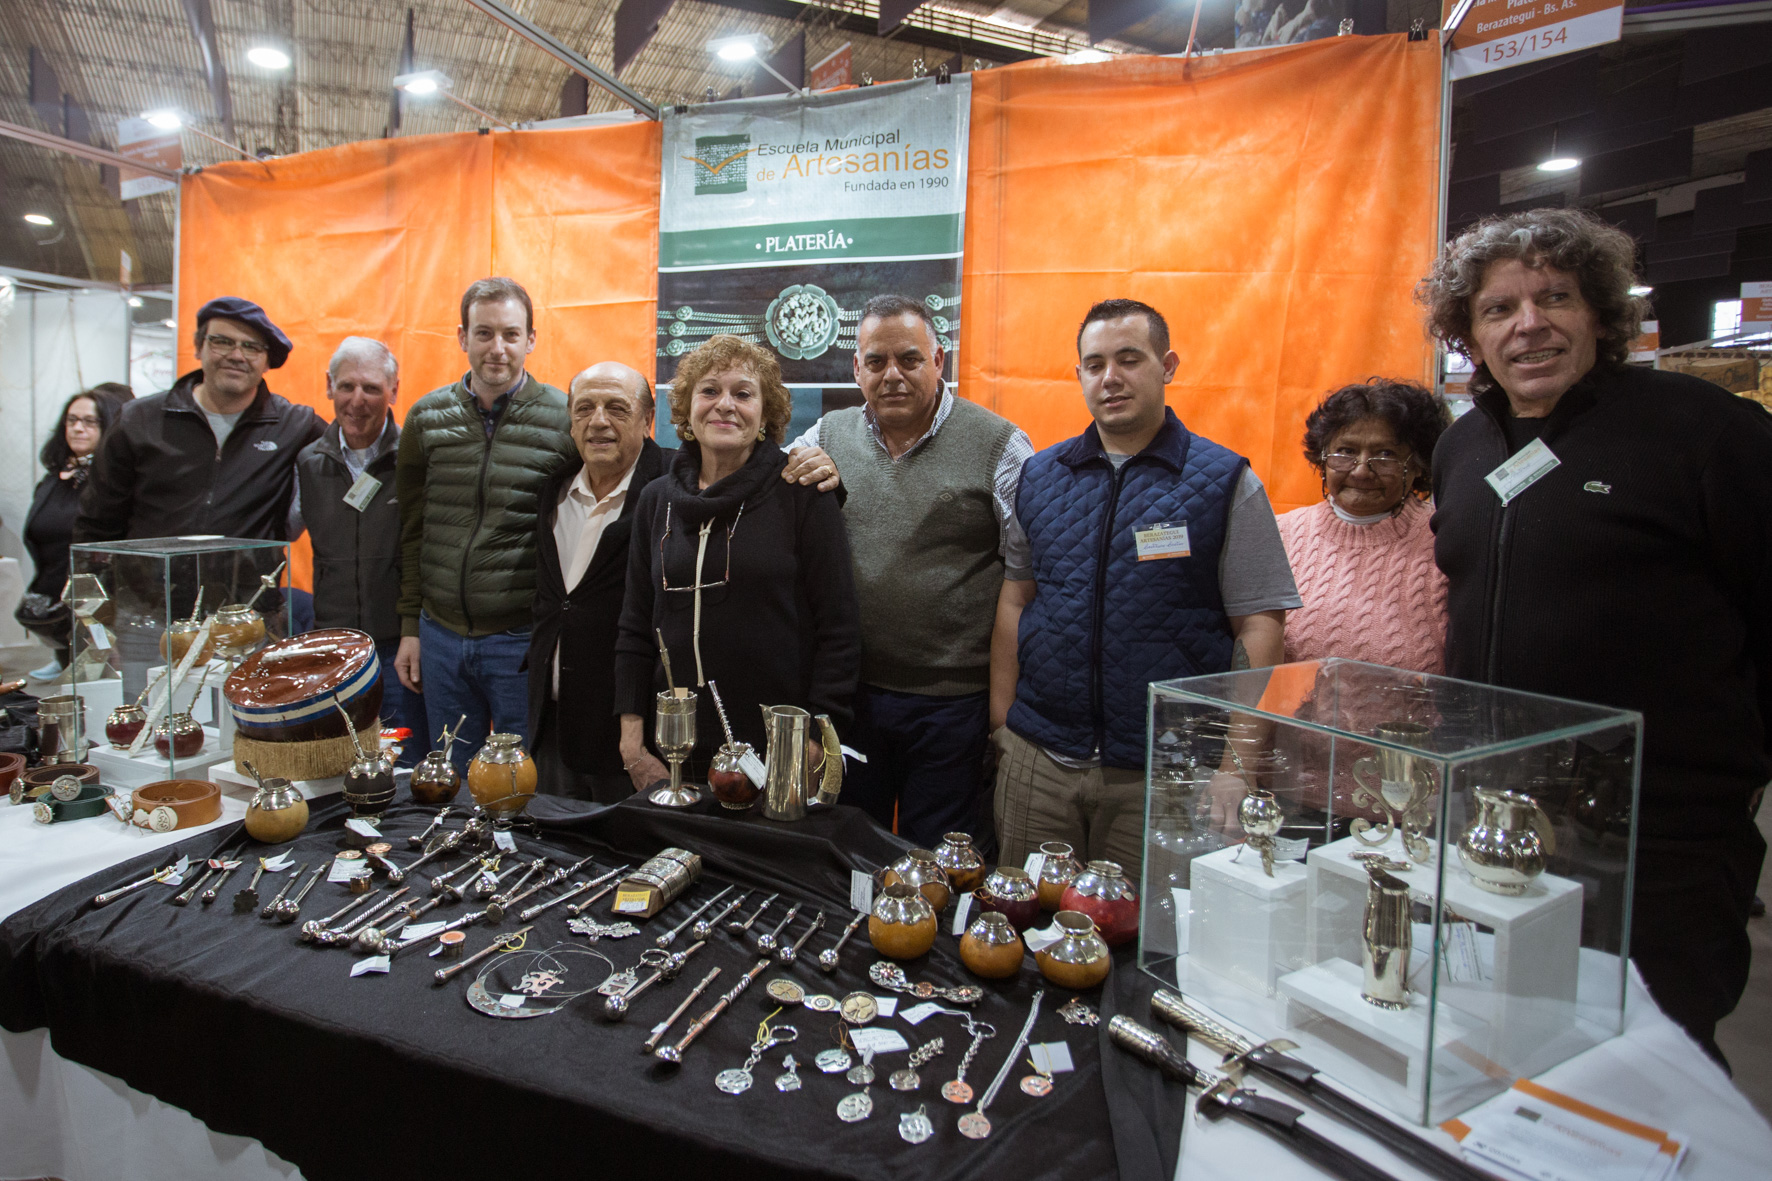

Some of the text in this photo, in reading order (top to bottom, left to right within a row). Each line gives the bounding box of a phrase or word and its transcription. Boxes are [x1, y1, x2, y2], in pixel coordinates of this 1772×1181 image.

[1476, 8, 1535, 34] Berazategui
[1544, 3, 1559, 15] Bs.
[1560, 0, 1577, 10] As.
[1482, 27, 1568, 63] 153/154
[757, 129, 900, 156] Escuela Municipal
[756, 144, 949, 182] de Artesanías
[844, 176, 949, 192] Fundada en 1990
[765, 229, 848, 253] PLATERÍA
